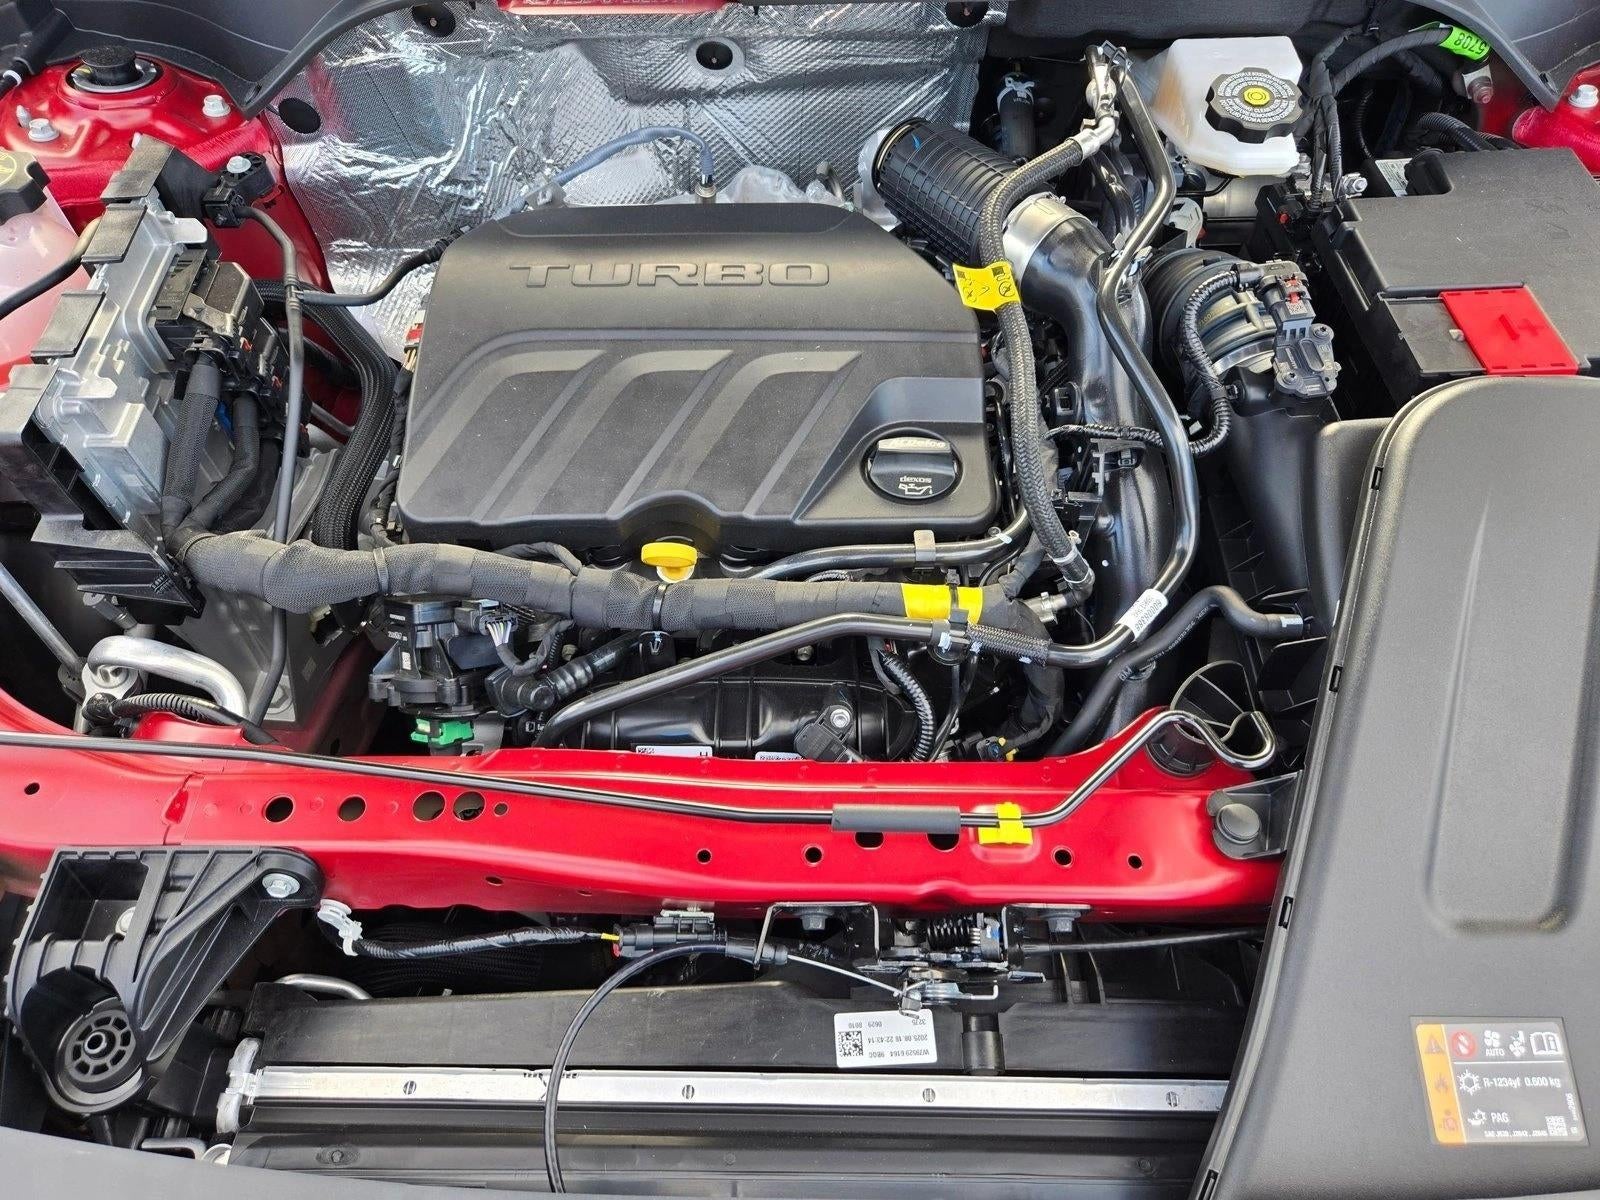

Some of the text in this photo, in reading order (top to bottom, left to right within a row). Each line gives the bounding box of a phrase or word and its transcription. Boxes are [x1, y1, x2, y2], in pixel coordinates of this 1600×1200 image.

[1454, 32, 1487, 55] 5708
[509, 263, 830, 288] TURBO
[899, 475, 932, 483] dexos
[1485, 1048, 1505, 1057] AUTO
[1483, 1076, 1561, 1089] R-1234yf 0.600 kg
[1490, 1112, 1509, 1123] PAG
